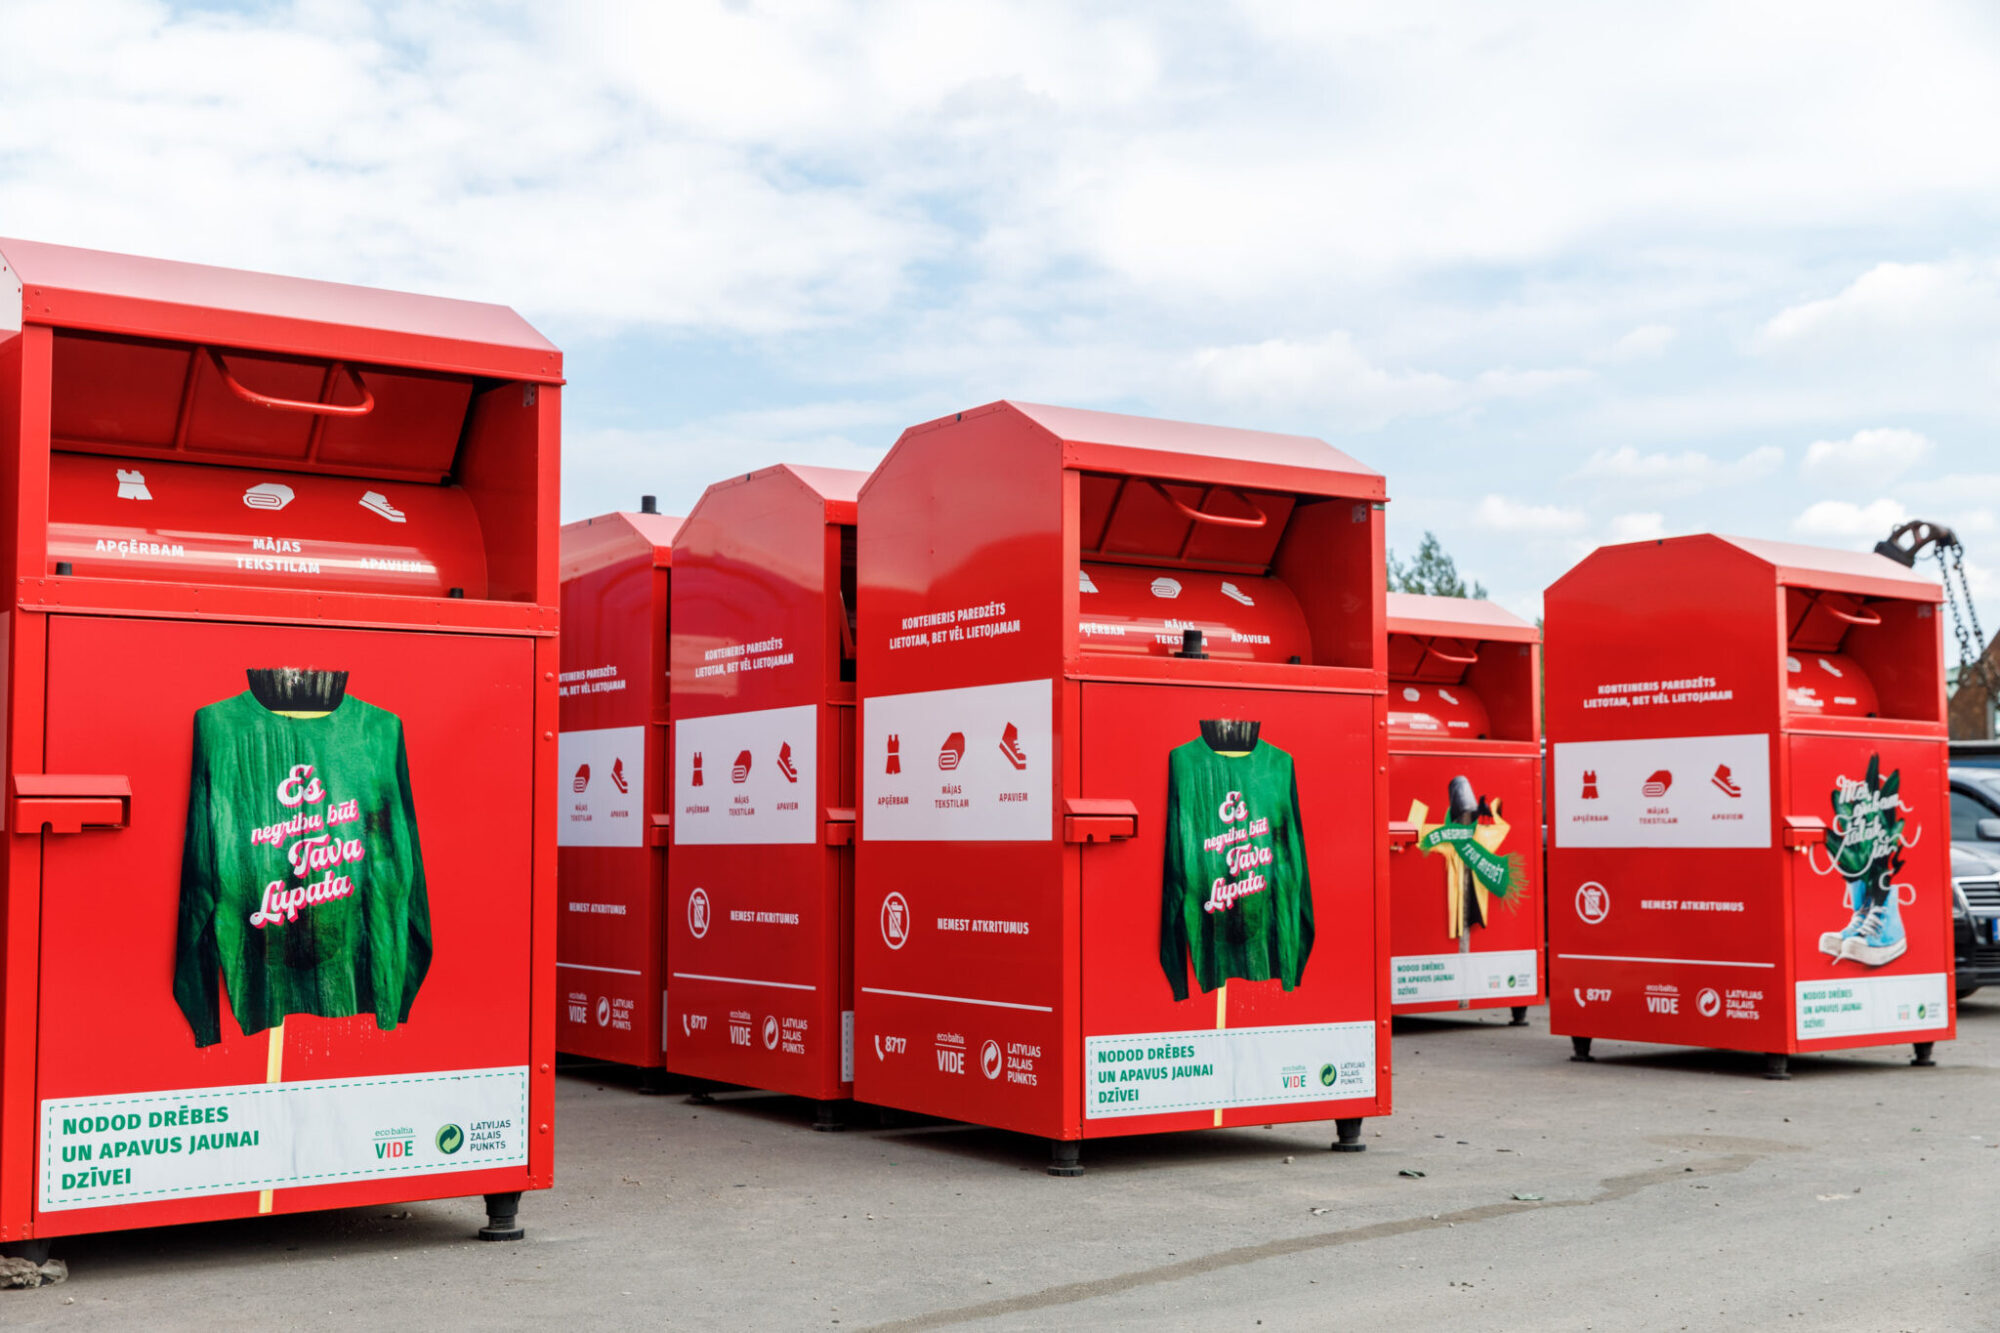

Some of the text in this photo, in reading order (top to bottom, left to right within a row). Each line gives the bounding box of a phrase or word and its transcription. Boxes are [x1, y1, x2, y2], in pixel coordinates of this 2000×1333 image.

[96, 539, 185, 558] APĢĒRBAM
[253, 537, 301, 553] MĀJAS
[236, 557, 320, 574] TEKSTILAM
[359, 558, 422, 573] APAVIEM
[902, 601, 1006, 631] KONTEINERIS PAREDZĒTS
[1164, 618, 1195, 631] MĀJAS
[889, 619, 1021, 650] LIETOTAM, BET VĒL LIETOJAMAM
[1079, 622, 1125, 637] PĢĒRBAM
[1231, 633, 1271, 645] APAVIEM
[704, 636, 783, 661] KONTEINERIS PAREDZĒTS
[727, 660, 739, 674] BET
[740, 656, 752, 671] VĒL
[753, 653, 794, 670] LIETOJAMAM
[1598, 676, 1716, 695] KONTEINERIS PAREDZĒTS
[1583, 690, 1733, 709] LIETOTAM, BET VĒL LIETOJAMAM
[277, 764, 326, 808] Es
[942, 782, 962, 796] MĀJAS
[776, 801, 799, 811] APAVIEM
[935, 798, 969, 809] TEKSTILAM
[999, 792, 1028, 802] APAVIEM
[1218, 791, 1249, 824] Es
[251, 798, 360, 848] negribu būt
[1203, 817, 1269, 854] negribu būt
[288, 834, 365, 879] Tava
[1226, 843, 1273, 877] Tava
[250, 870, 355, 929] Lupata
[1203, 870, 1267, 914] Lupata
[1641, 900, 1744, 912] NEMEST ATKRITUMUS
[730, 910, 799, 925] NEMEST ATKRITUMUS
[937, 917, 1029, 935] NEMEST ATKRITUMUS
[1586, 989, 1612, 1002] 8717
[1725, 989, 1763, 1000] LATVIJAS
[569, 1005, 587, 1024] VIDE
[1646, 997, 1679, 1015] VIDE
[691, 1014, 708, 1030] 8717
[782, 1017, 808, 1030] LATVIJAS
[729, 1025, 751, 1047] VIDE
[885, 1036, 907, 1054] 8717
[782, 1041, 805, 1055] PUNKTS
[1007, 1042, 1041, 1058] LATVIJAS
[1098, 1044, 1195, 1063] NODOD DRĒBES
[937, 1050, 965, 1075] VIDE
[1007, 1071, 1037, 1086] PUNKTS
[1098, 1064, 1214, 1084] UN APAVUS JAUNAI
[1282, 1075, 1306, 1088] VIDE
[1098, 1087, 1139, 1104] DZĪVEI
[62, 1105, 229, 1135] NODOD DRĒBES
[470, 1119, 511, 1131] LATVIJAS
[62, 1130, 259, 1162] UN APAVUS JAUNAI
[375, 1140, 413, 1159] VIDE
[470, 1141, 506, 1152] PUNKTS
[61, 1167, 131, 1190] DZĪVEI
